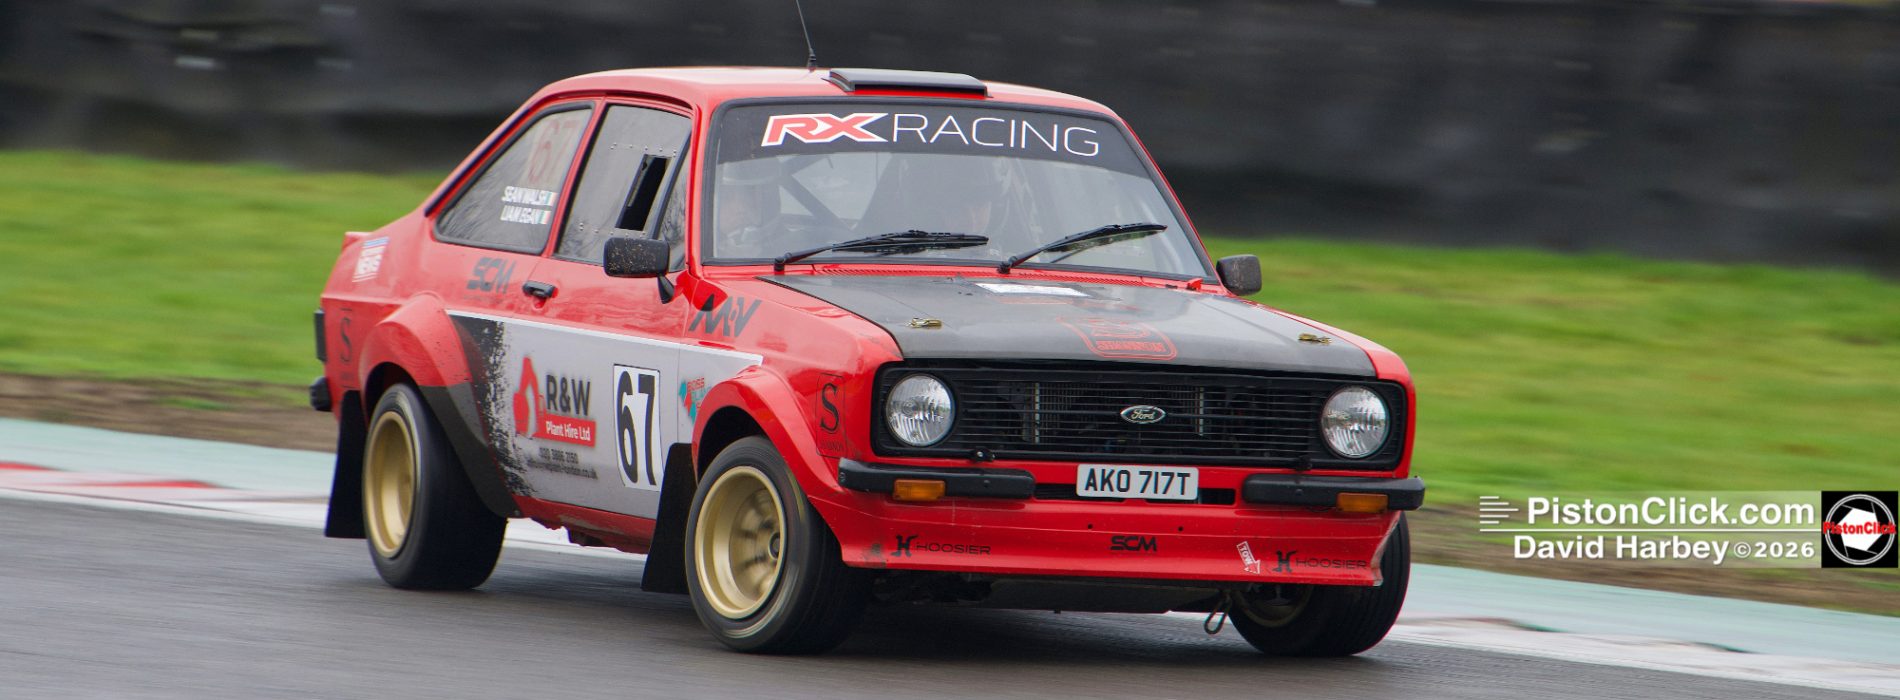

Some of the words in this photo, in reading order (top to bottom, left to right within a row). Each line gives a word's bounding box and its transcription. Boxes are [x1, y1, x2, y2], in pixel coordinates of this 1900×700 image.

[761, 112, 889, 147] RX
[893, 113, 1100, 157] RACING
[545, 374, 591, 416] R&W
[820, 382, 840, 434] S
[1131, 408, 1156, 420] Ford
[545, 420, 564, 437] Plant
[564, 423, 579, 440] Hire
[579, 426, 591, 441] Ltd
[616, 370, 657, 486] 67
[1084, 467, 1131, 493] AKO
[1138, 470, 1191, 496] 717T
[916, 542, 992, 556] HOOSIER
[1110, 535, 1158, 552] SCM
[1295, 557, 1368, 570] HOOSIER
